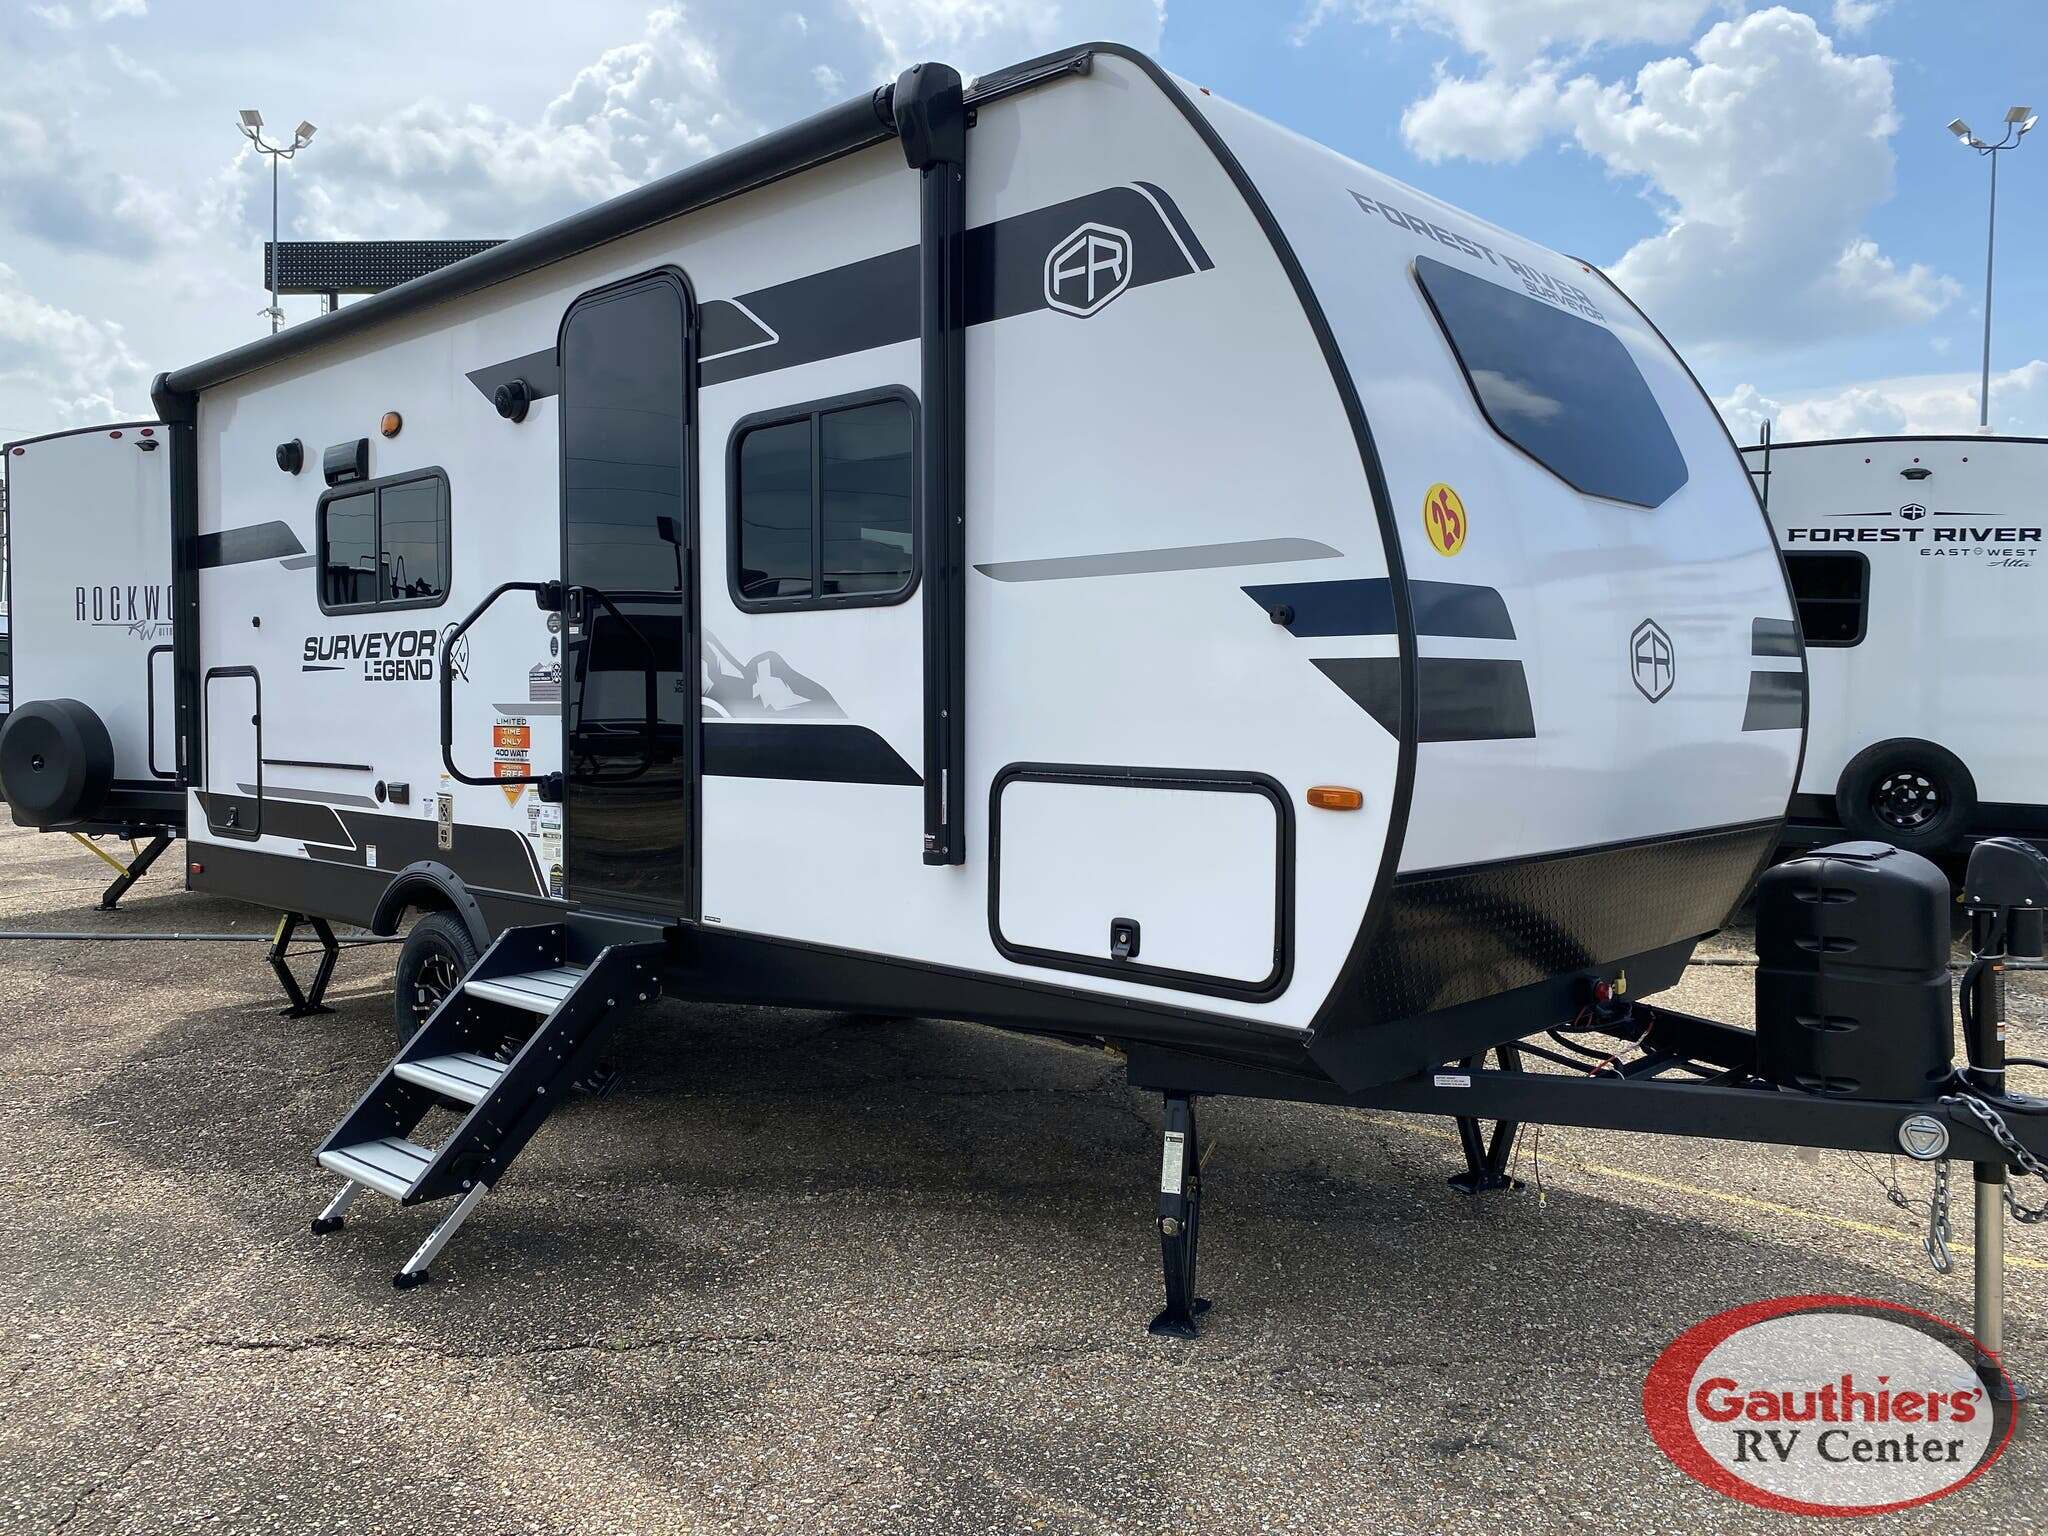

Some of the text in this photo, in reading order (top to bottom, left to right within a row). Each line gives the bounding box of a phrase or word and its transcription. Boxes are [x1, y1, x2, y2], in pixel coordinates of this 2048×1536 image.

[1345, 187, 1598, 308] FOREST RIVER
[1521, 277, 1608, 324] SURVEYOR
[1431, 488, 1461, 551] 25
[1788, 527, 2043, 542] FOREST RIVER
[1920, 548, 2038, 557] EAST WEST
[303, 629, 437, 661] SURVEYOR
[364, 658, 433, 682] LEGEND
[502, 728, 521, 736] TIME
[501, 738, 522, 746] ONLY
[495, 749, 529, 758] 400 WATT
[500, 769, 524, 777] FREE
